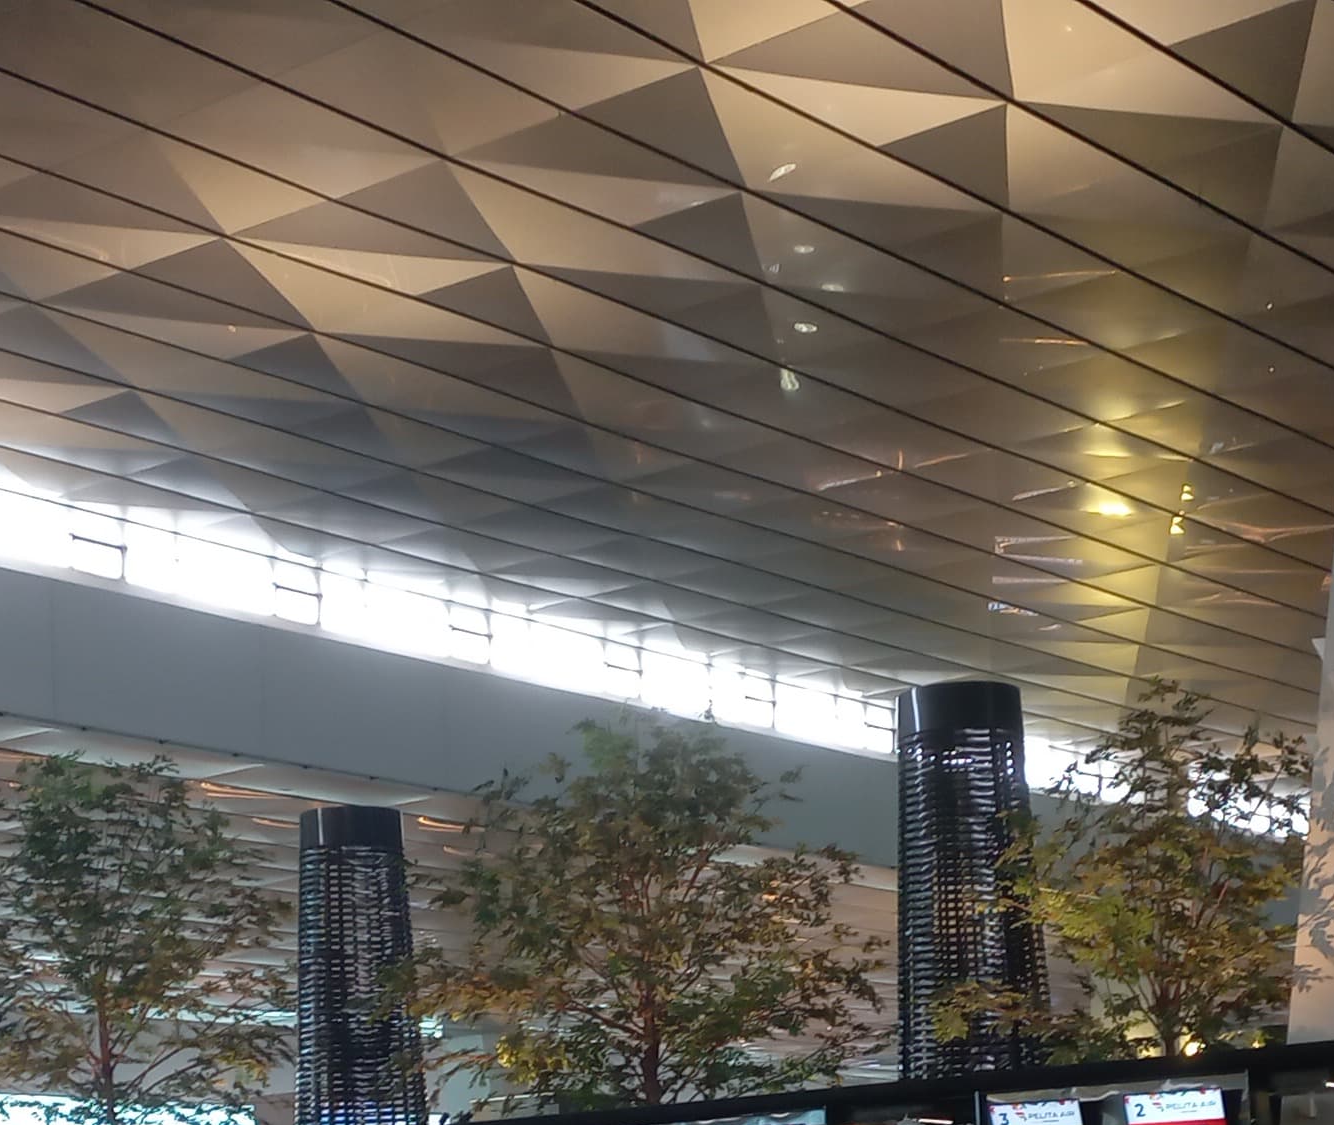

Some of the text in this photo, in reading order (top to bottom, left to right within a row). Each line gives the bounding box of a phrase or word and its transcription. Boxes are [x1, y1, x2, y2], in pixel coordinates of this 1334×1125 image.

[1134, 1103, 1146, 1117] 2
[1165, 1102, 1197, 1110] PELITA
[998, 1113, 1009, 1125] 3
